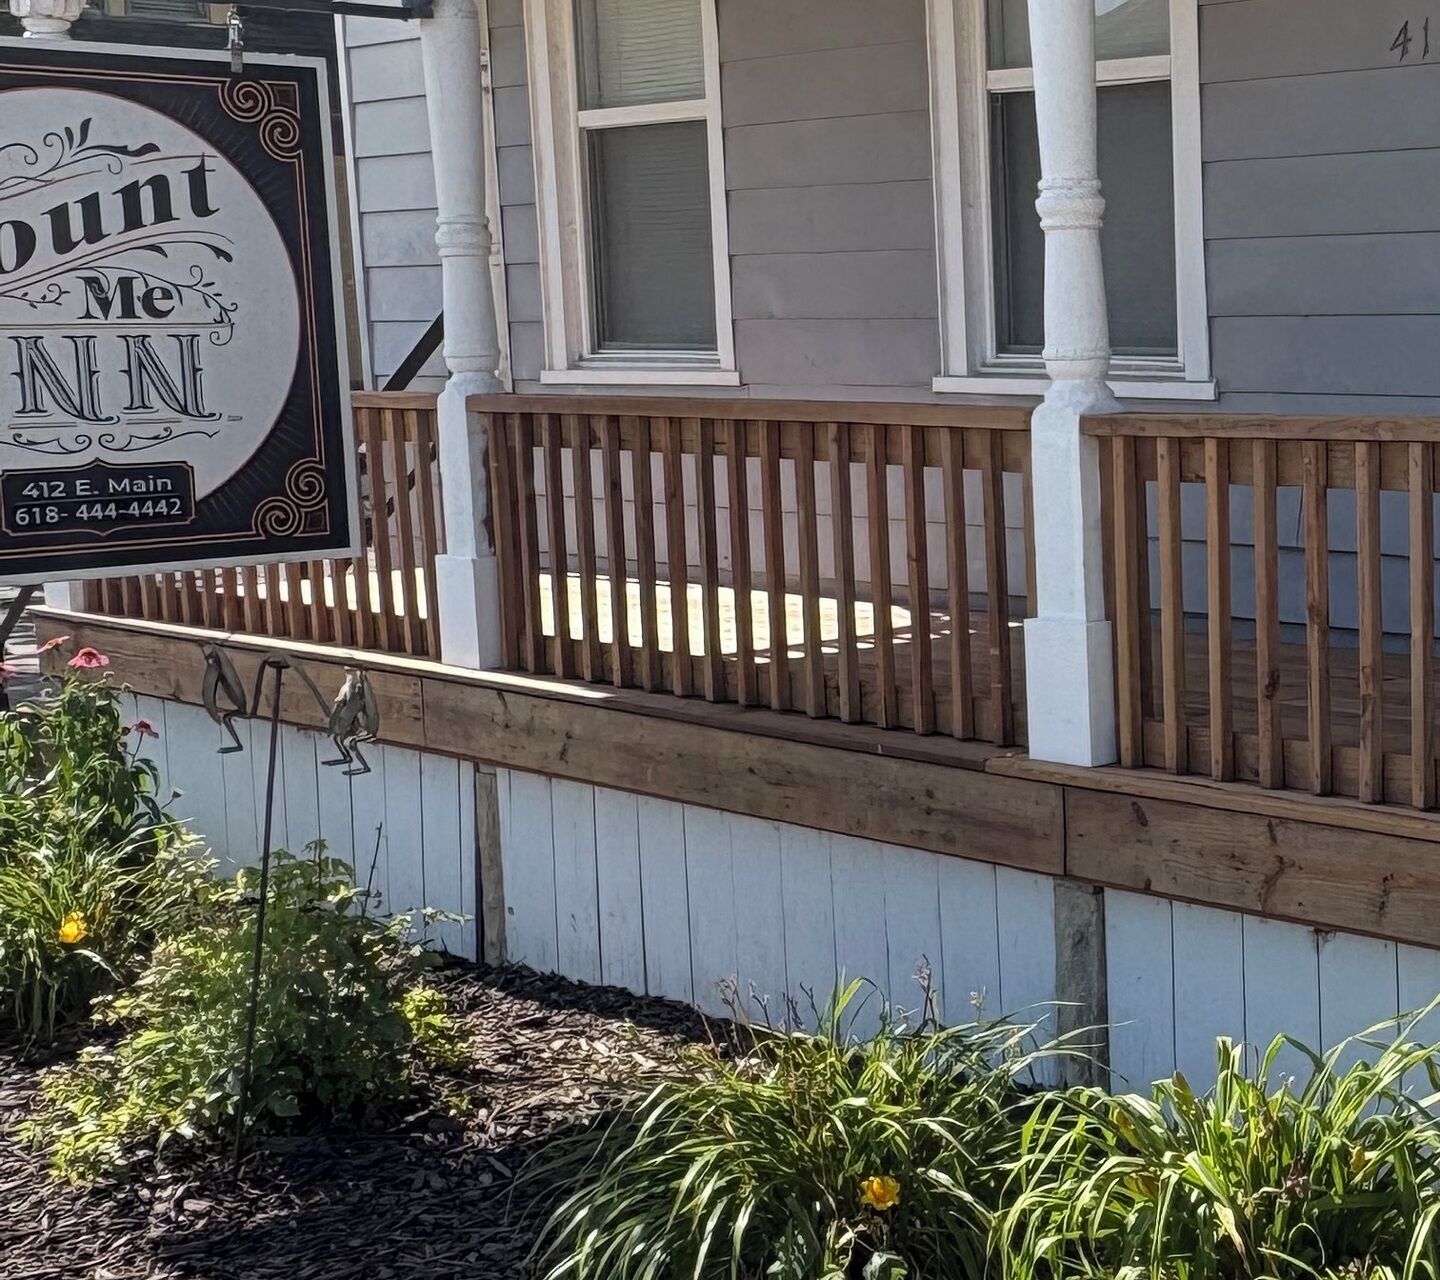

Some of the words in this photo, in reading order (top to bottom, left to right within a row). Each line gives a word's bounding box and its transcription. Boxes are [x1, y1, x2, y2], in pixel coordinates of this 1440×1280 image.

[75, 276, 176, 320] Me
[22, 480, 67, 499] 412
[75, 479, 100, 496] E.
[108, 475, 173, 494] Main
